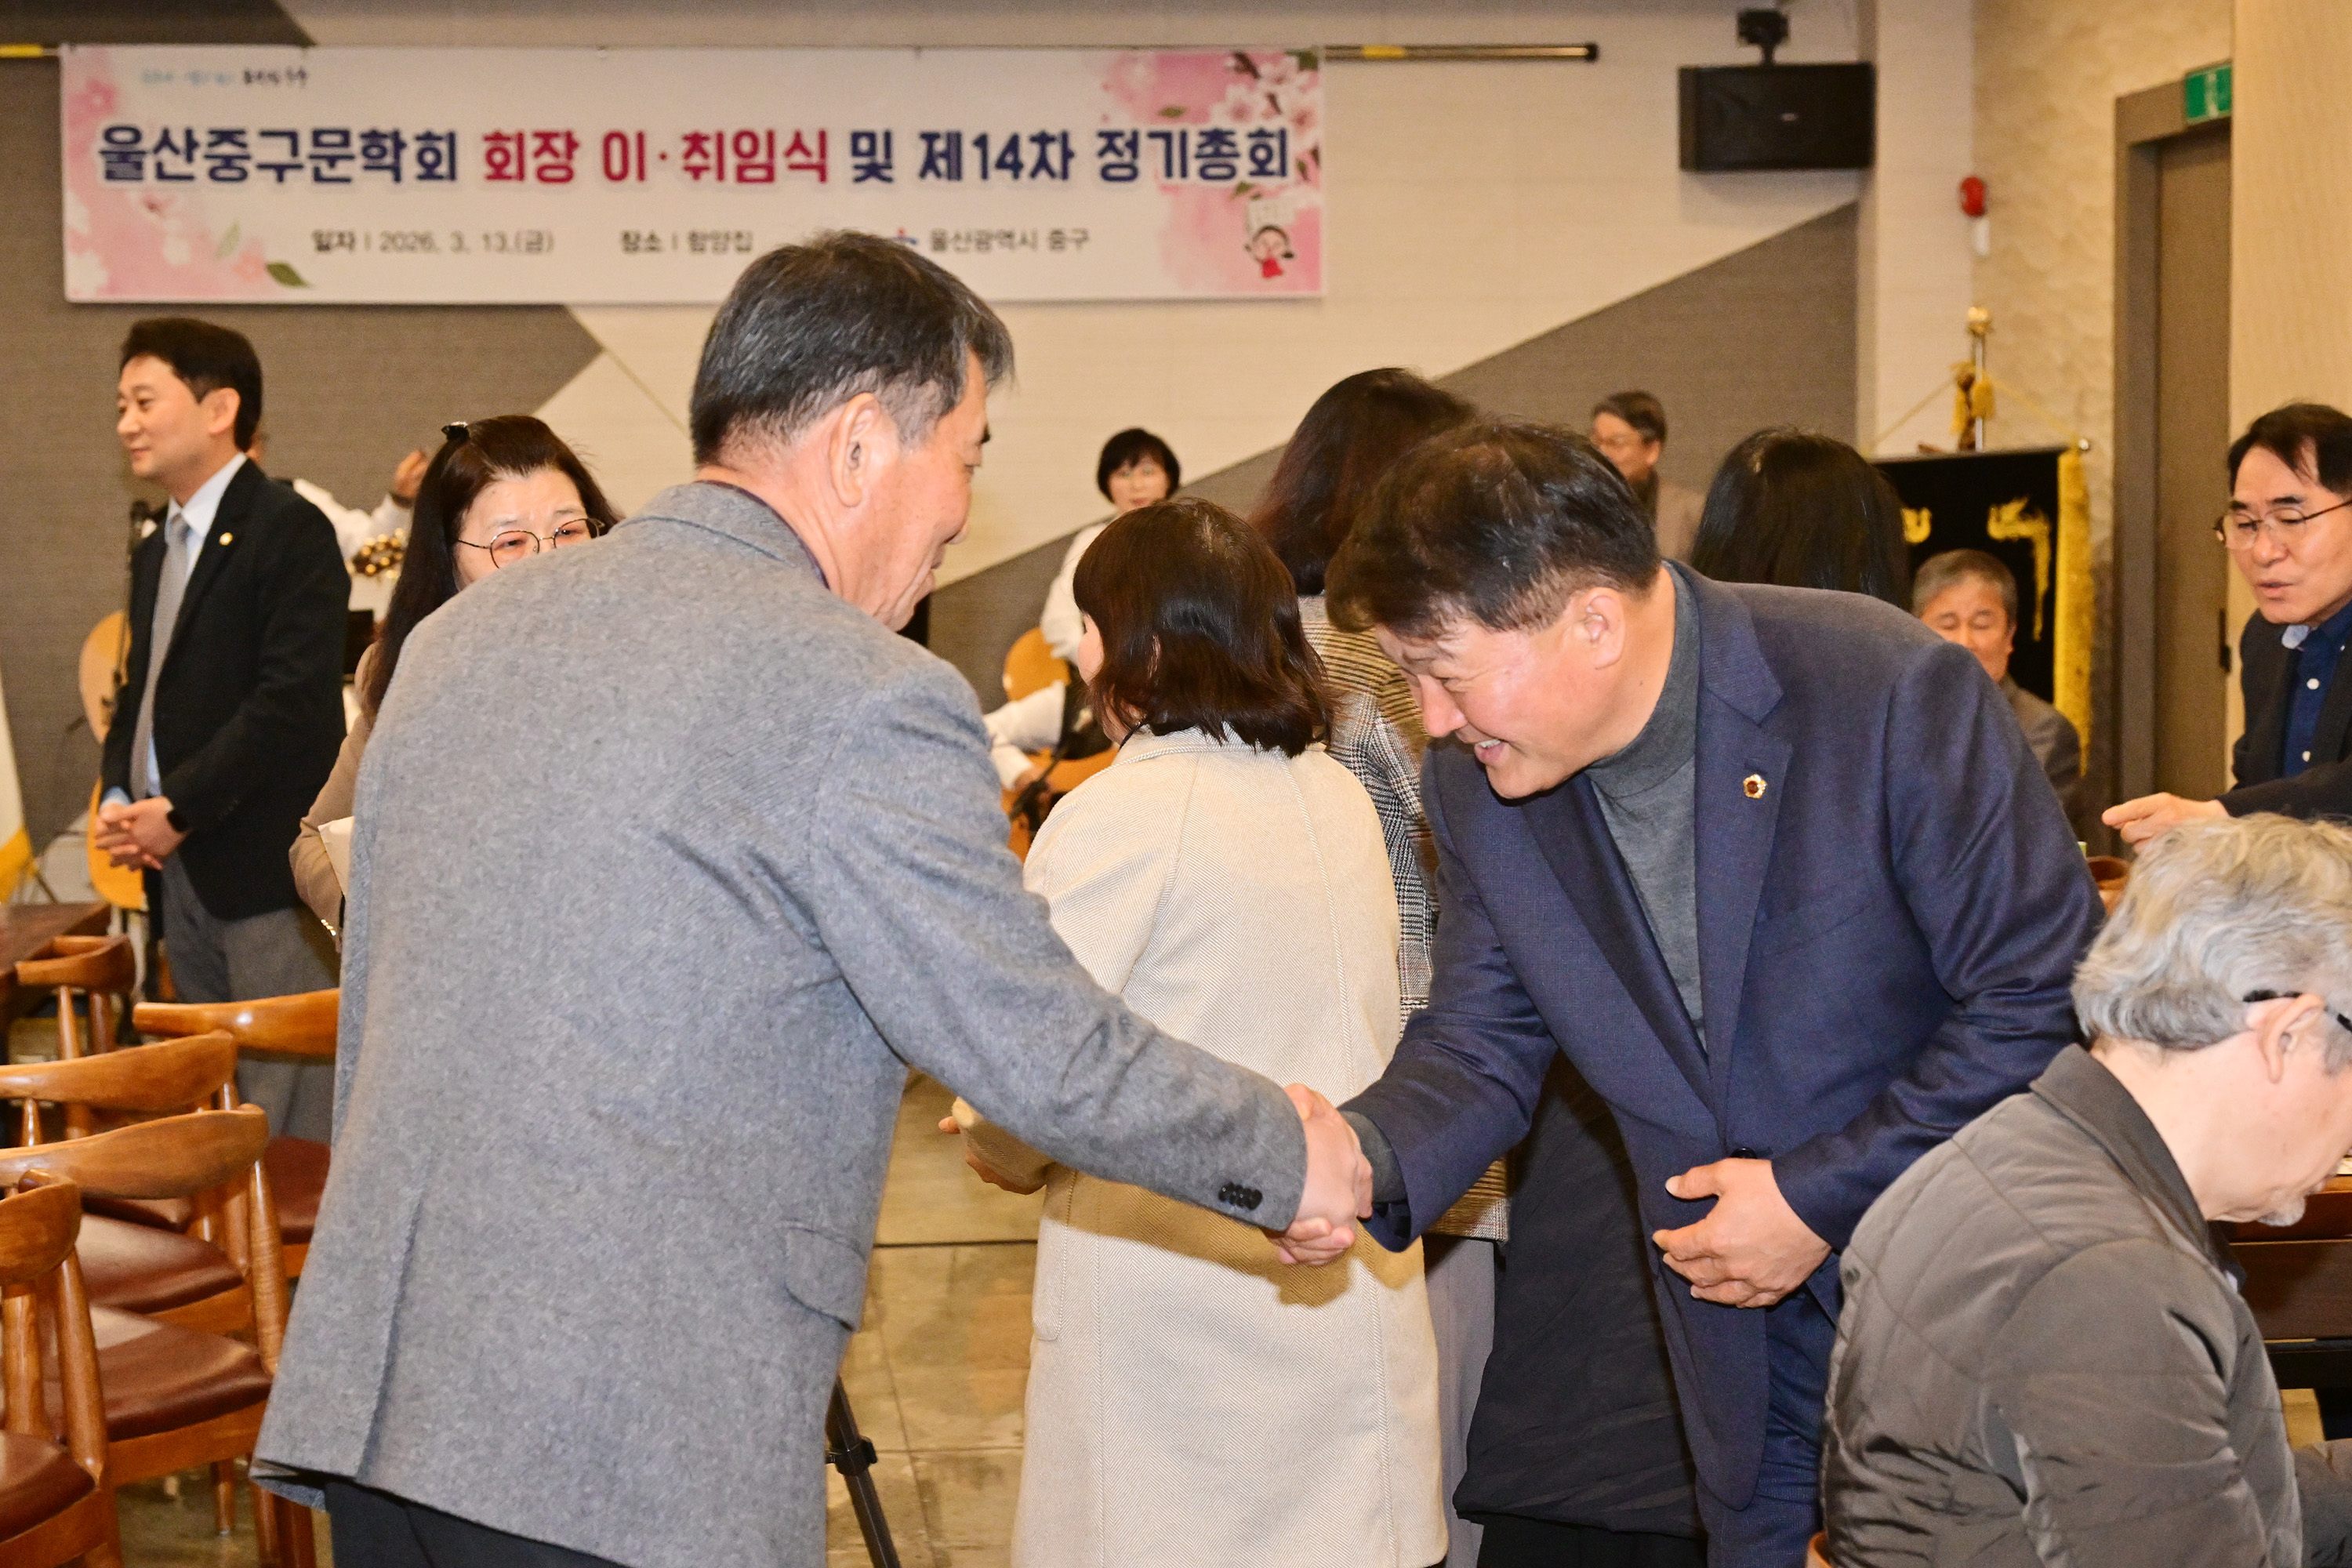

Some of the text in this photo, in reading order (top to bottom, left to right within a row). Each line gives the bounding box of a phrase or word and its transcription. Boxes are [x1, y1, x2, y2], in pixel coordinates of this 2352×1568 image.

[99, 125, 456, 183] 울산중구문학회
[482, 129, 580, 184] 회장
[850, 129, 894, 183] 및
[919, 129, 1076, 181] 제14차
[1096, 127, 1289, 182] 정기총회
[312, 229, 358, 254] 일자
[622, 230, 662, 254] 장소
[931, 227, 1089, 253] 울산광역시 중구
